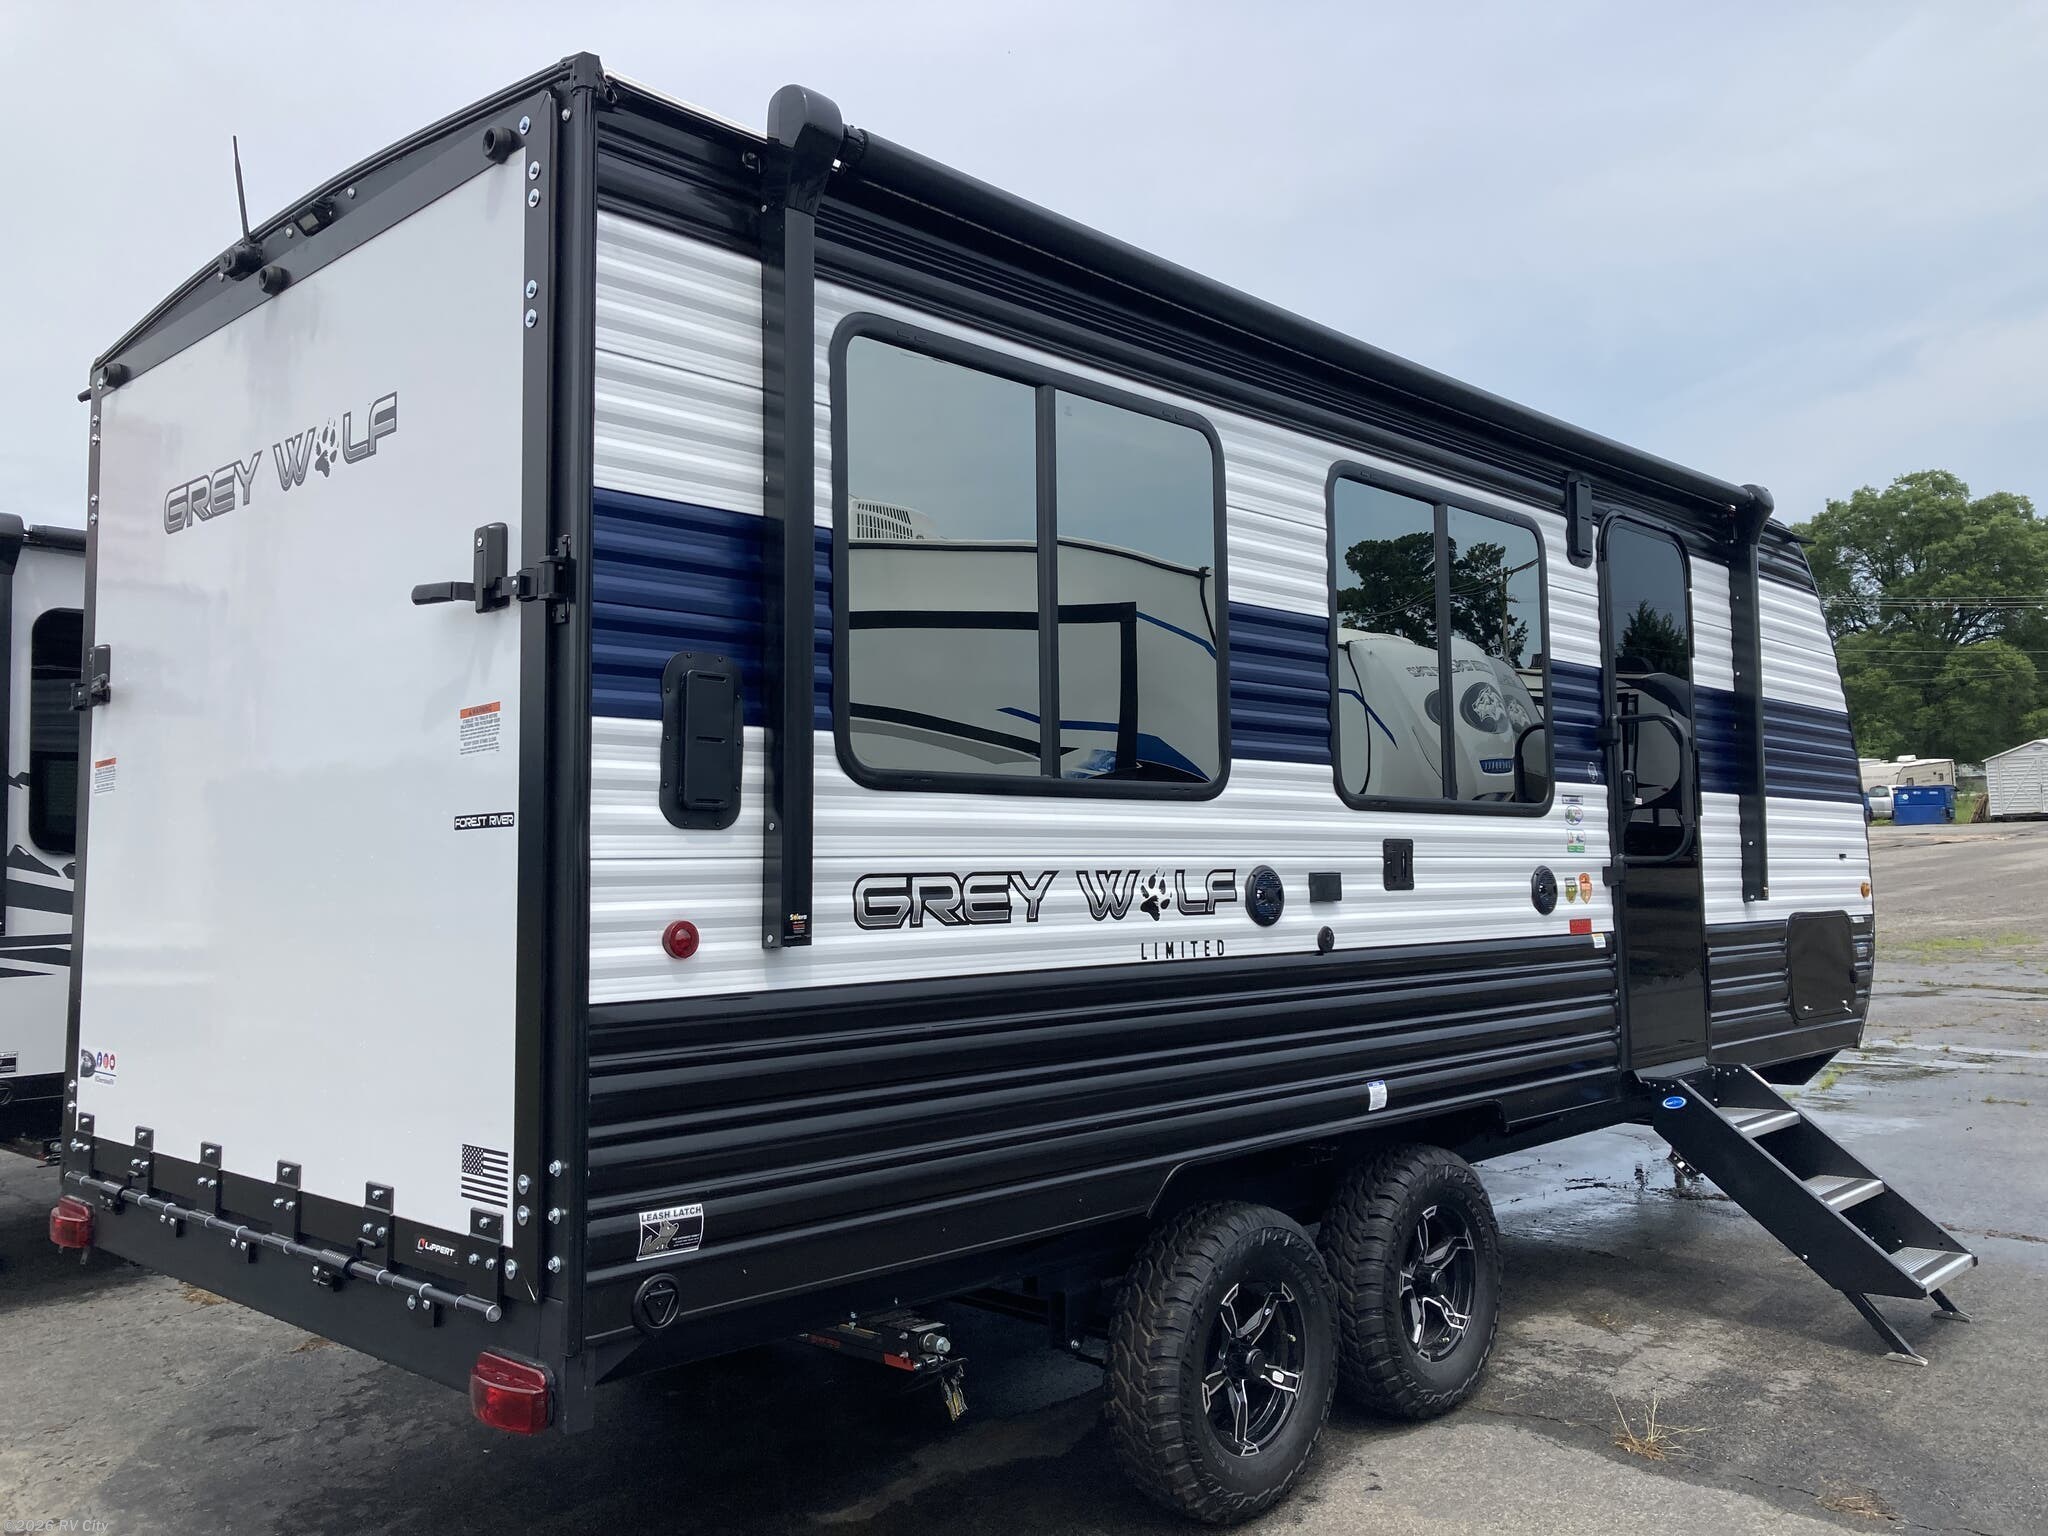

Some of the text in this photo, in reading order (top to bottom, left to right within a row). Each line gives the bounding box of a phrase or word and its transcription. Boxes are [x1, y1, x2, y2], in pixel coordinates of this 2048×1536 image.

[164, 450, 263, 535] GREY
[455, 814, 514, 828] FOREST RIVER
[852, 870, 1059, 930] GREY
[1140, 939, 1225, 961] LIMITED
[641, 1205, 702, 1223] LEASH LATCH
